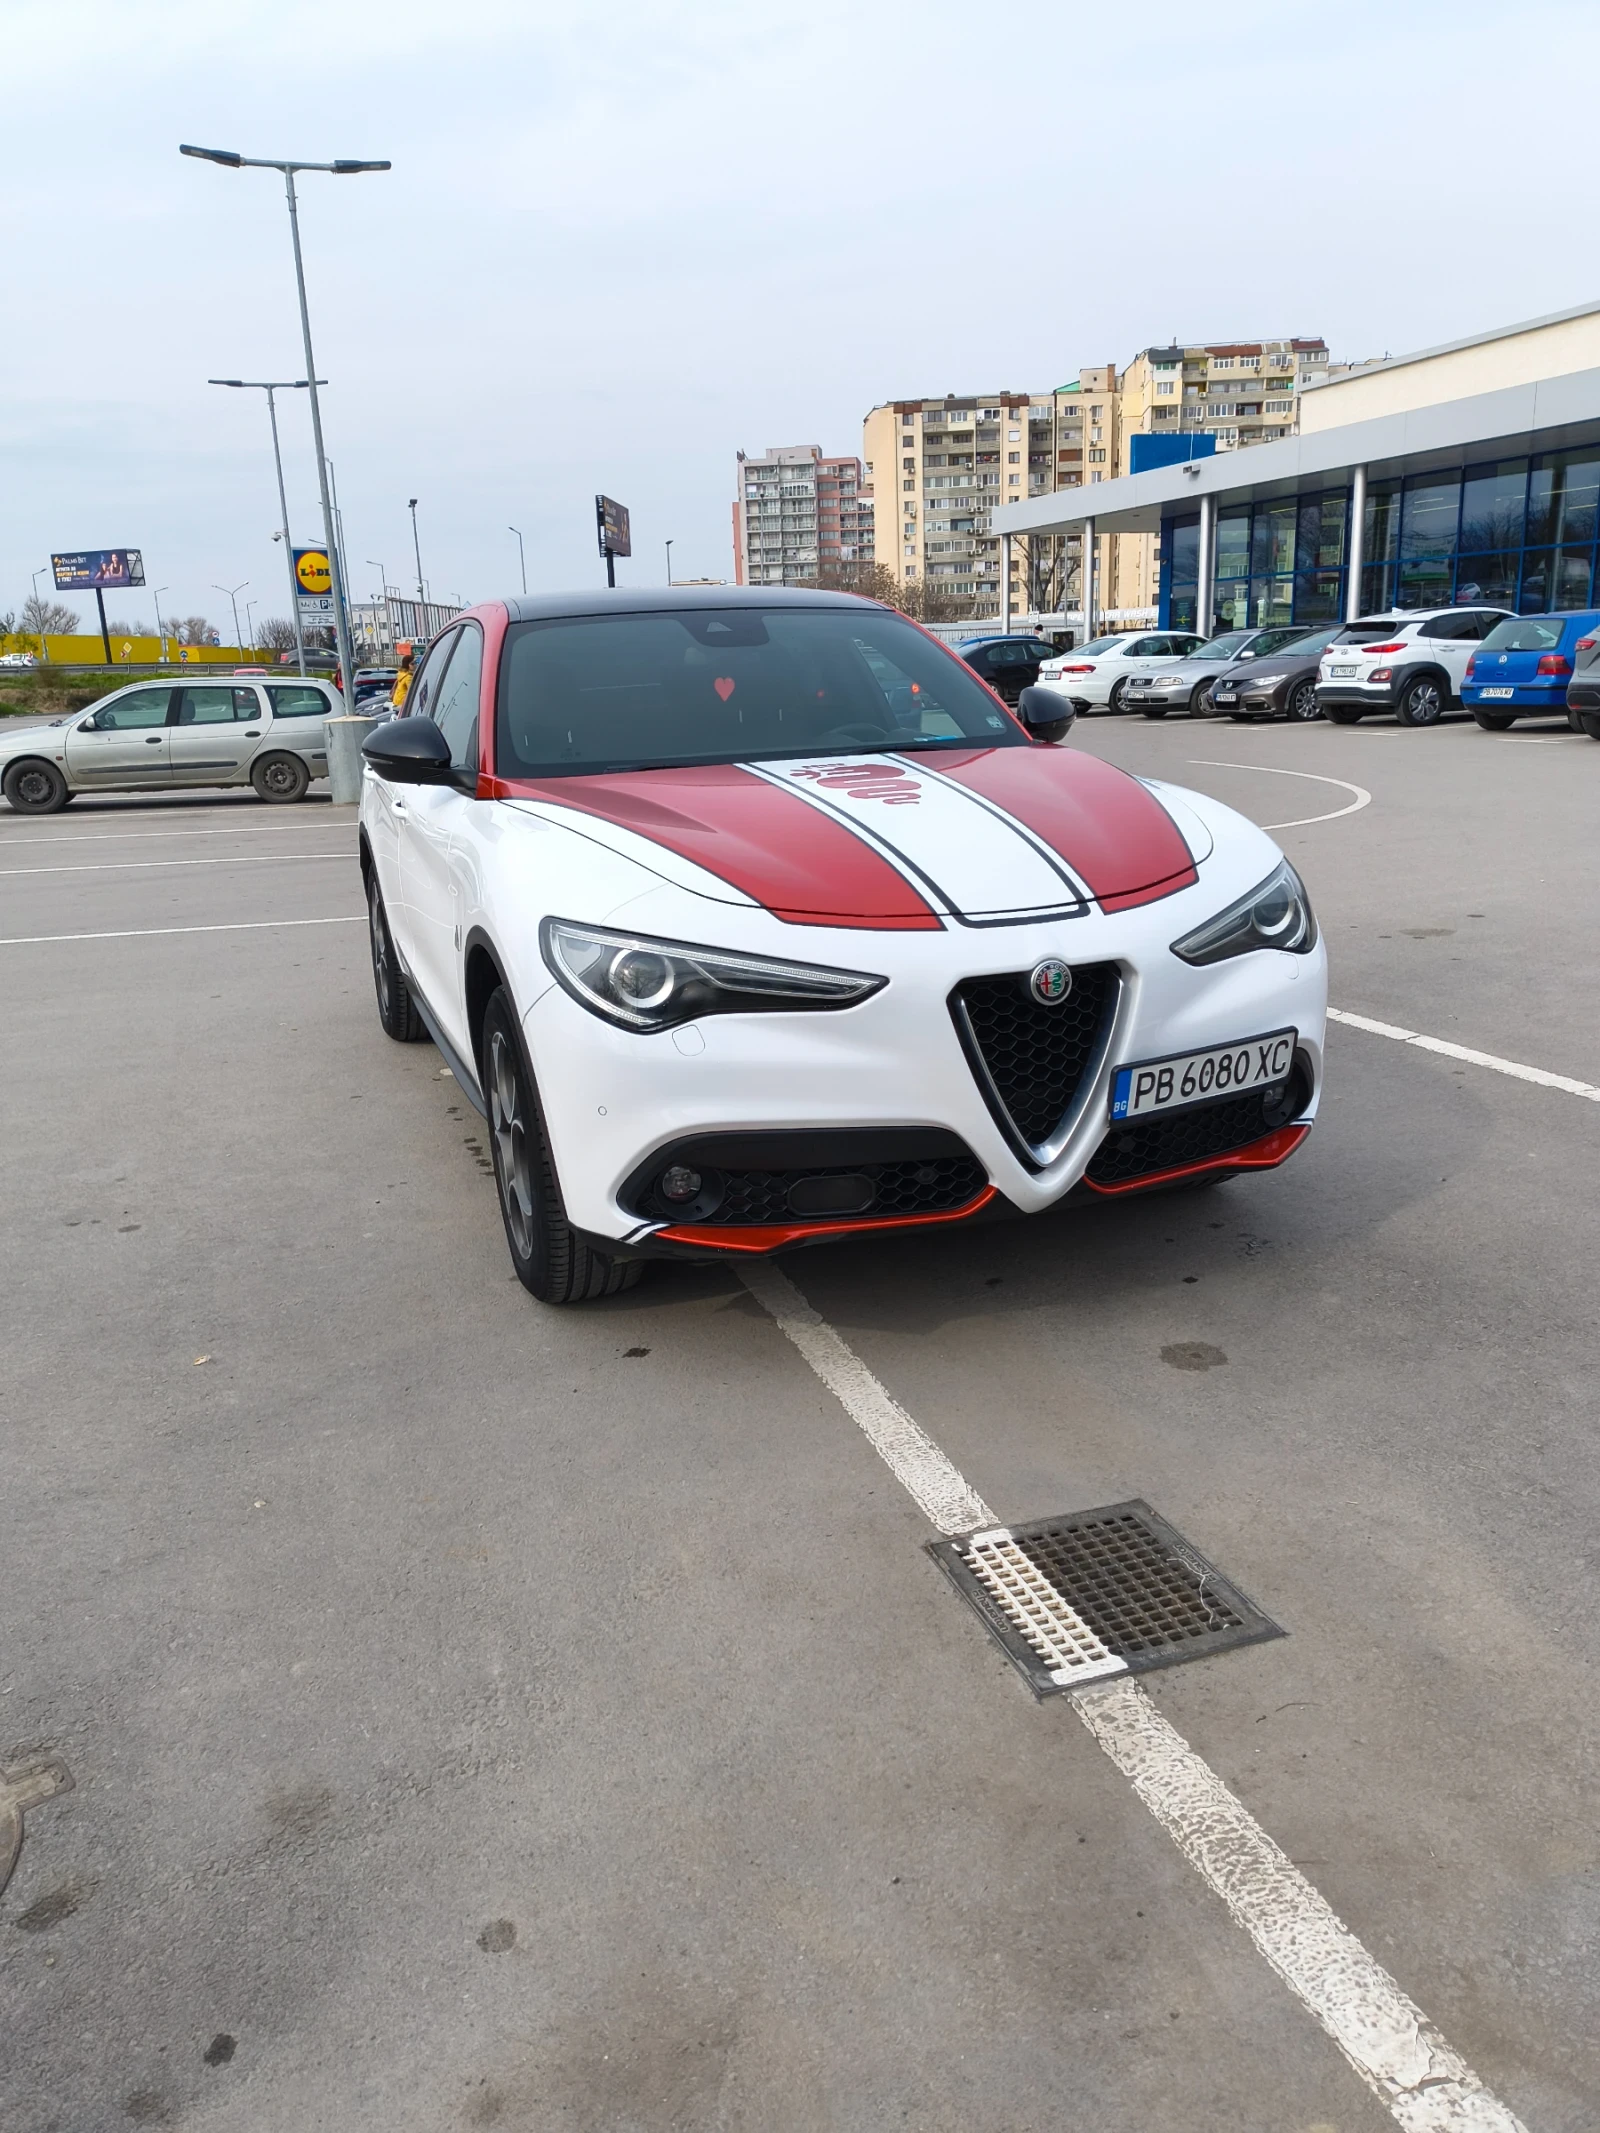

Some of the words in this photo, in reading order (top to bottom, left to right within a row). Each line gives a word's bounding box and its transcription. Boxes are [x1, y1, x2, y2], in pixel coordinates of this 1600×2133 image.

[1124, 608, 1147, 618] WASH
[1133, 1067, 1175, 1109] PB
[1180, 1050, 1250, 1097] 6080
[1253, 1039, 1289, 1081] XC
[1113, 1100, 1127, 1112] BG
